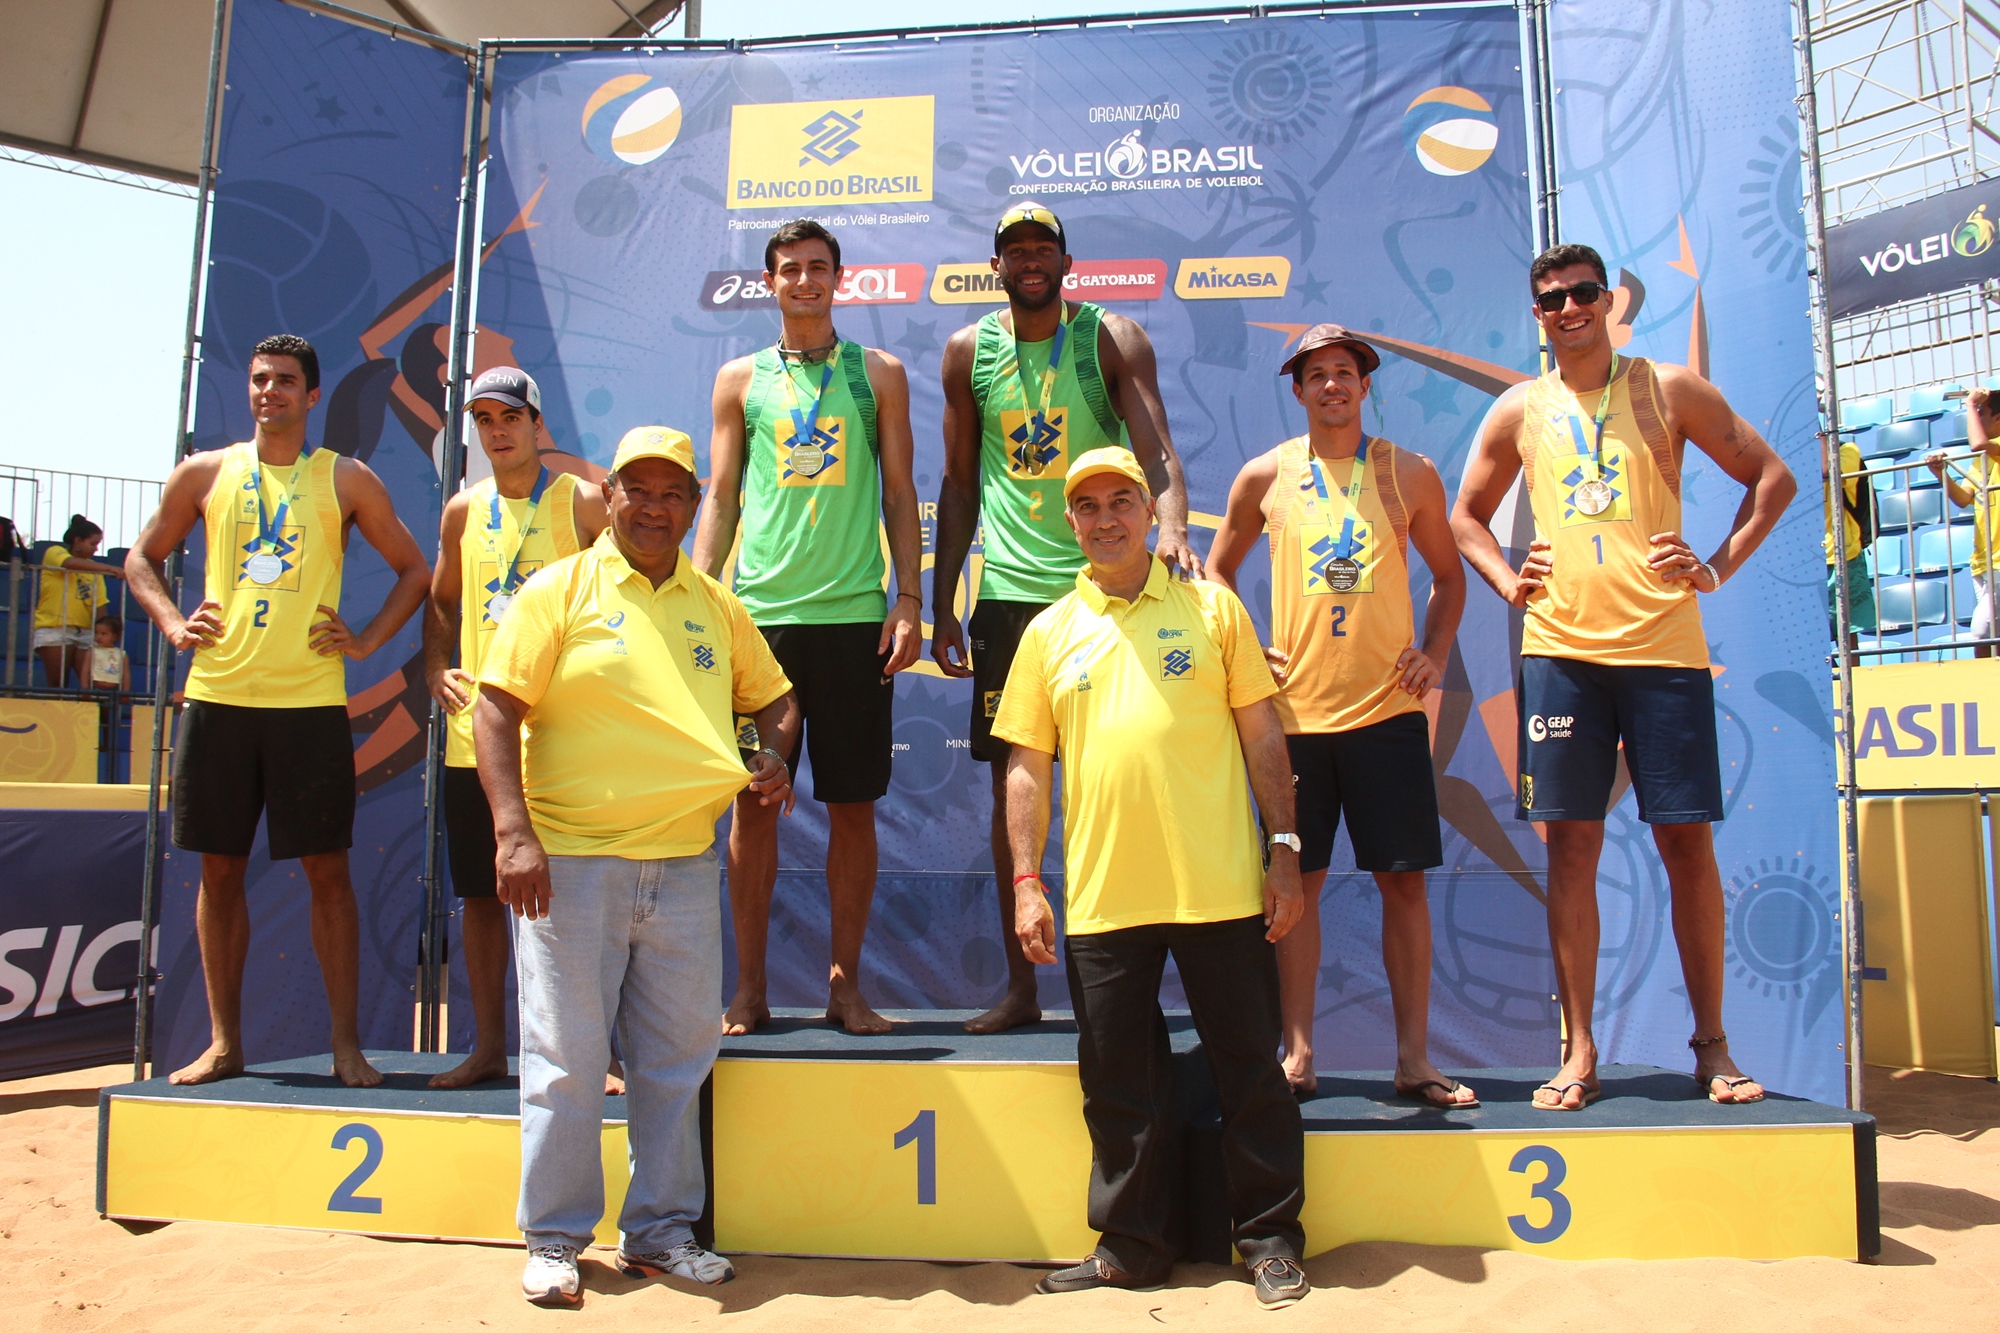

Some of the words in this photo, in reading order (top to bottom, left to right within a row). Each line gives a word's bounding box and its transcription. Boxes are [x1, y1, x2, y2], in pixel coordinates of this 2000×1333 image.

[1088, 103, 1180, 123] ORGANIZAÇÃO
[1009, 148, 1101, 178] VÔLEI
[1151, 145, 1263, 174] BRASIL
[815, 178, 844, 196] DO
[847, 174, 923, 195] BRASIL
[1009, 179, 1108, 195] CONFEDERAÇÃO
[1111, 178, 1182, 191] BRASILEIRA
[1185, 178, 1202, 189] DE
[1206, 175, 1264, 188] VOLEIBOL
[833, 215, 847, 226] do
[849, 213, 877, 226] Vôlei
[879, 212, 930, 225] Brasileiro
[1859, 232, 1949, 277] VÔLEI
[833, 268, 907, 302] GOL
[1080, 273, 1156, 287] GATORADE
[807, 498, 816, 526] 1
[1029, 490, 1043, 521] 2
[1591, 534, 1603, 565] 1
[253, 599, 269, 627] 2
[1331, 605, 1347, 637] 2
[1547, 716, 1574, 728] GEAP
[1549, 728, 1572, 738] saúde
[327, 1123, 384, 1214] 2
[893, 1109, 937, 1205] 1
[1506, 1144, 1572, 1244] 3
